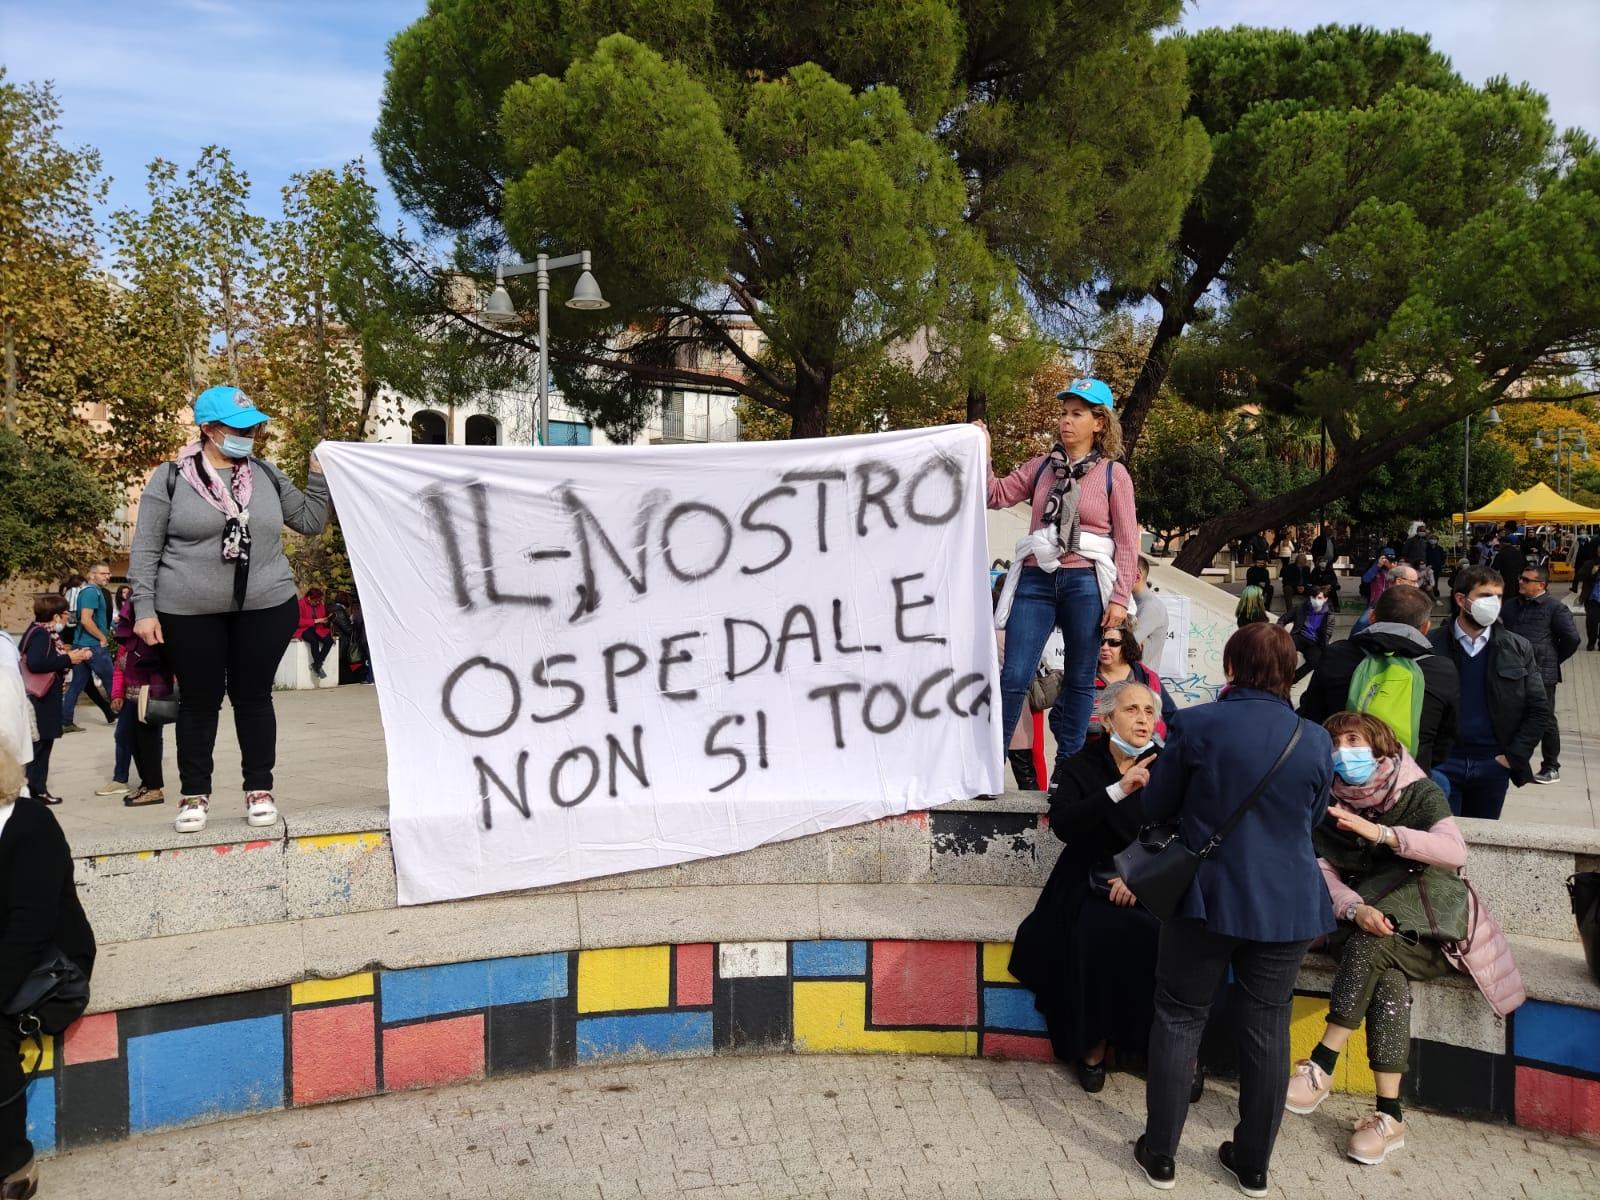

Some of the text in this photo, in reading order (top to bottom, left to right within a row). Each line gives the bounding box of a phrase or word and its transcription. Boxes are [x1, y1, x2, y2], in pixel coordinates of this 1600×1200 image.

[441, 573, 947, 737] OSPEDALE
[473, 724, 650, 829] NON
[705, 710, 768, 793] SI
